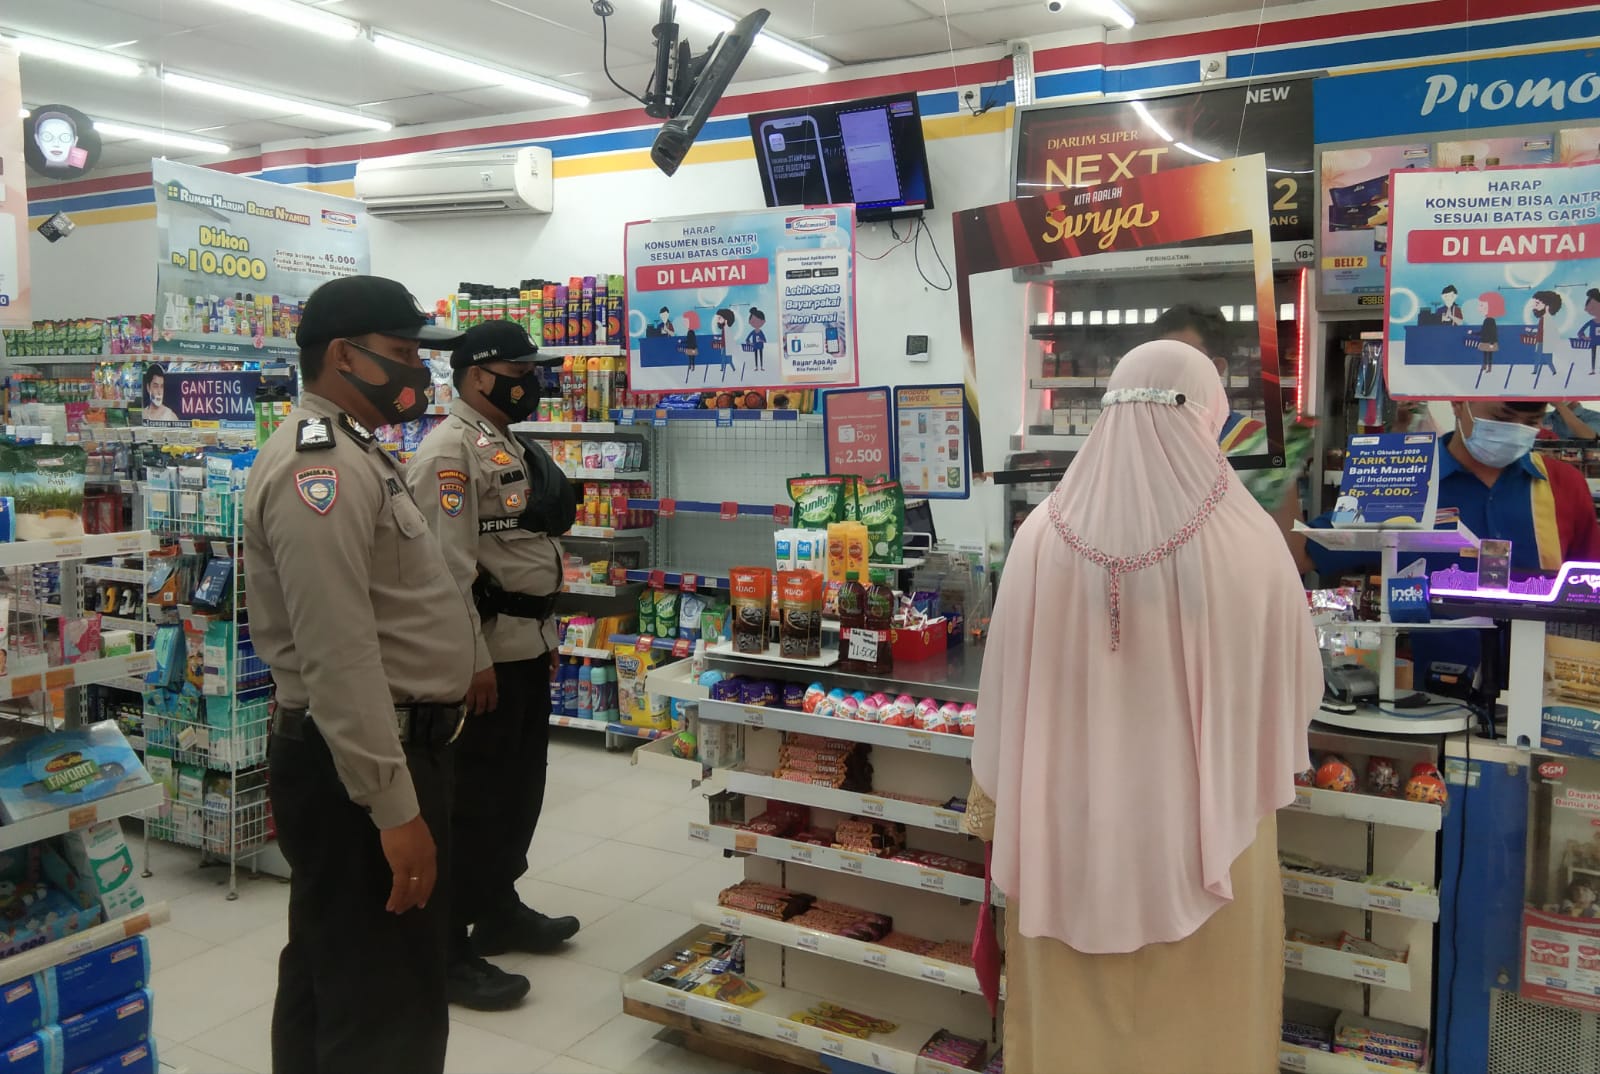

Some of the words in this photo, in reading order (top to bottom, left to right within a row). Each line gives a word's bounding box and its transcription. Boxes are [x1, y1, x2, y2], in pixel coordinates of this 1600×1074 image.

[1246, 86, 1290, 105] NEW
[1047, 136, 1096, 152] DJARUM
[1099, 130, 1139, 146] SUPER
[1045, 147, 1169, 192] NEXT
[1487, 180, 1542, 193] HARAP
[1073, 192, 1091, 206] KITA
[1092, 187, 1123, 203] ADALAH
[1424, 196, 1512, 209] KONSUMEN
[1517, 194, 1553, 206] BISA
[1558, 191, 1600, 205] ANTR
[1433, 212, 1488, 225] SESUAI
[1492, 210, 1542, 223] BATAS
[1548, 207, 1596, 221] GARIS
[682, 225, 717, 237] HARAP
[1042, 203, 1159, 249] Surya
[199, 225, 250, 253] Diskon
[644, 237, 698, 252] KONSUMEN
[701, 235, 725, 247] BISA
[727, 233, 758, 246] ANTRI
[1442, 236, 1470, 257] DI
[1479, 232, 1586, 257] LANTAI
[324, 253, 356, 265] 45.000
[650, 250, 685, 263] SESUAI
[687, 247, 719, 260] BATAS
[720, 246, 752, 258] GARIS
[1296, 250, 1315, 260] 18+
[172, 252, 187, 268] Rp
[188, 248, 268, 281] 10.000
[657, 269, 675, 285] DI
[680, 264, 747, 284] LANTAI
[785, 285, 811, 296] Lebih
[812, 283, 841, 295] Sehat
[786, 299, 812, 311] Bayar
[812, 296, 841, 309] pakai
[790, 314, 809, 325] Non
[810, 311, 837, 324] Tunai
[181, 380, 241, 396] GANTENG
[181, 397, 256, 415] MAKSIMA
[856, 431, 877, 444] Pay
[846, 449, 882, 463] 2.500
[1351, 457, 1387, 465] TARIK
[1390, 455, 1429, 465] TUNAI
[1349, 466, 1378, 476] Bank
[1380, 464, 1427, 474] Mandiri
[1367, 475, 1417, 483] Indomaret
[1348, 488, 1369, 498] Rp.
[1371, 487, 1421, 498] 4.000,-
[1391, 584, 1424, 597] indo
[1543, 712, 1583, 727] Belanja
[48, 761, 94, 789] FAVORIT
[1541, 765, 1564, 775] SGM
[1567, 789, 1600, 801] Dapatk
[1554, 798, 1585, 810] Bonus
[1587, 803, 1600, 811] Po
